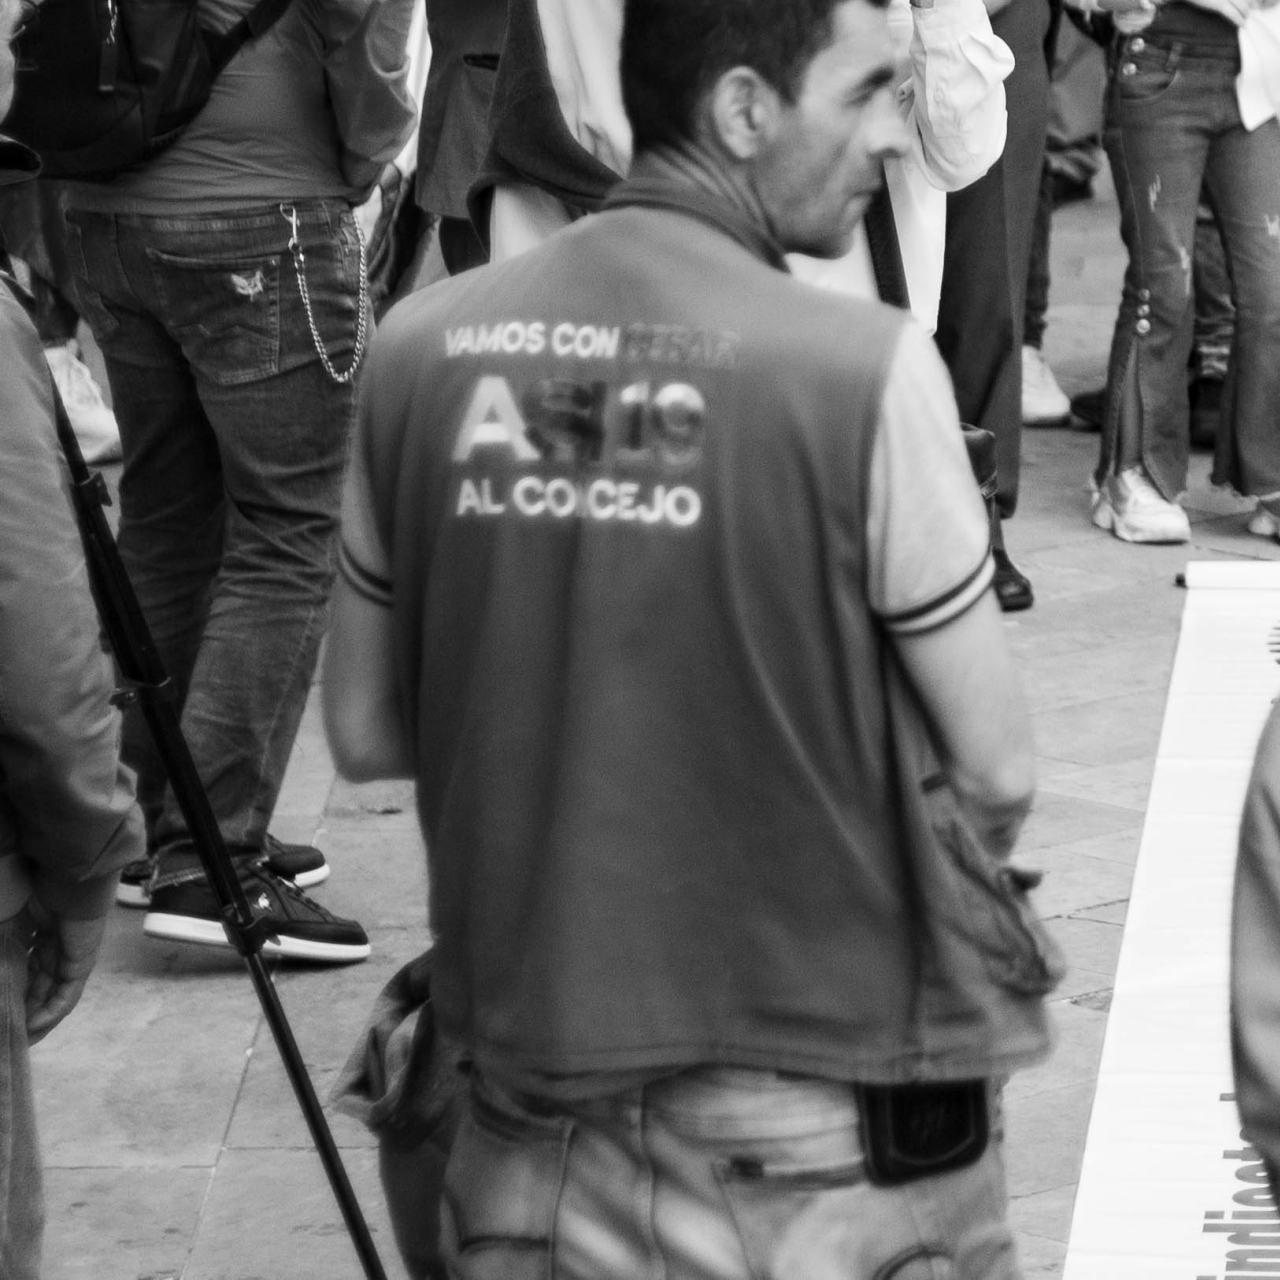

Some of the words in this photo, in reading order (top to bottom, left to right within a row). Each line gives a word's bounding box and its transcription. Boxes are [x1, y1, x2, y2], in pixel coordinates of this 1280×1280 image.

[446, 321, 546, 359] VAMOS
[552, 321, 620, 360] CON
[456, 477, 506, 517] AL
[512, 476, 702, 527] COCEJO
